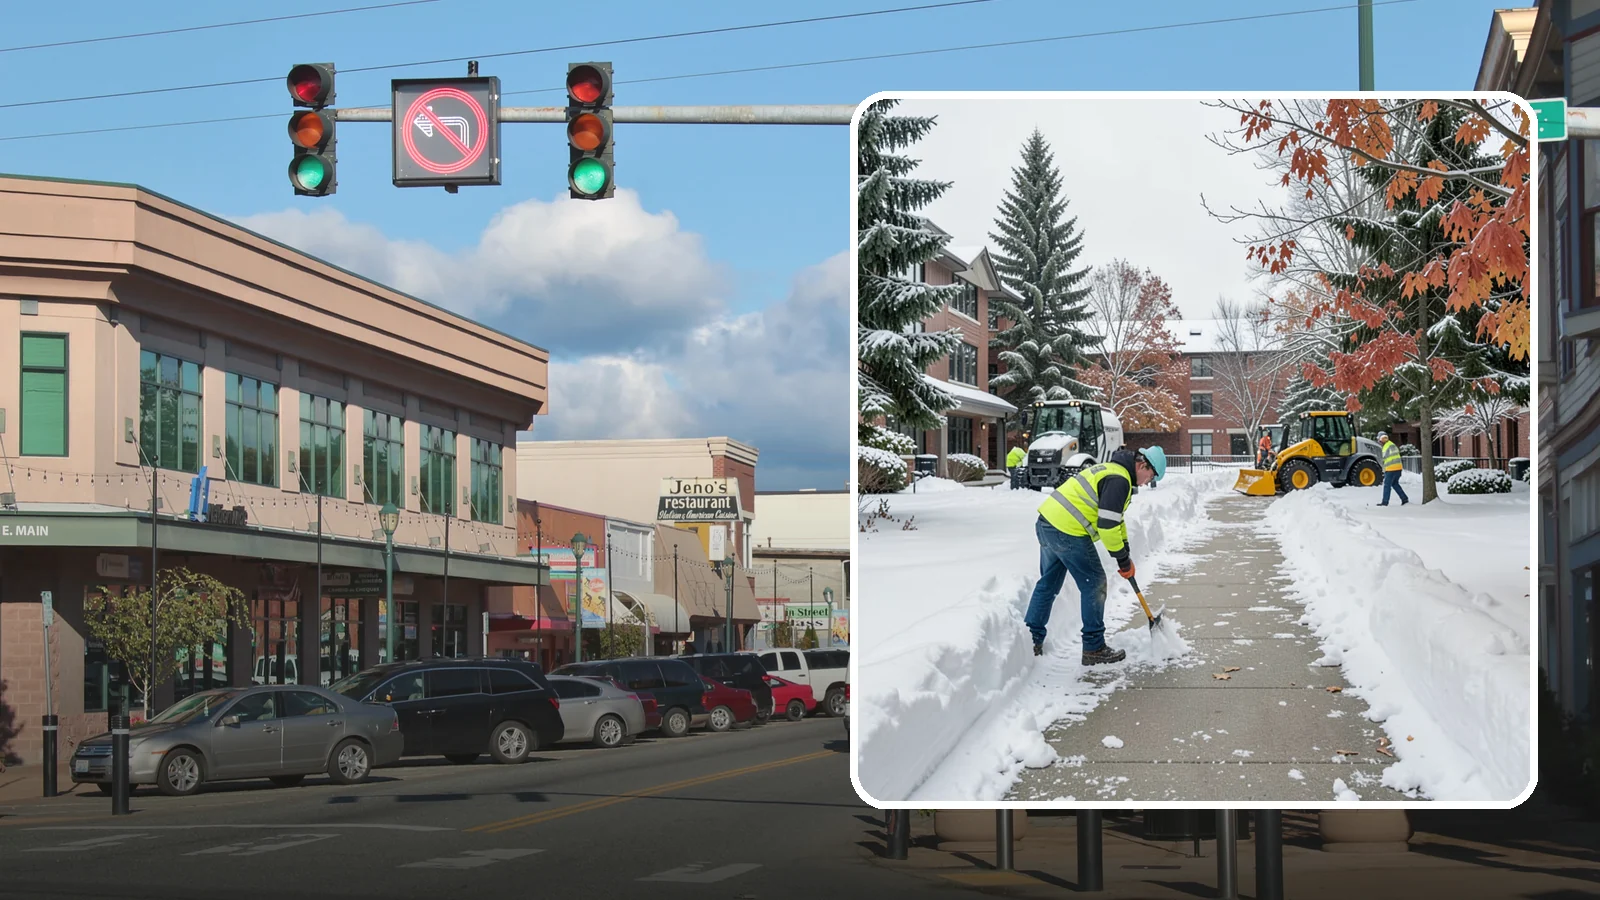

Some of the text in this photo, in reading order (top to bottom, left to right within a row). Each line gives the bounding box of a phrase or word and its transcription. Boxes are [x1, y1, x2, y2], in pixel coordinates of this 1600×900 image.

[669, 480, 728, 495] Jeno's
[664, 496, 731, 509] restaurant
[658, 510, 682, 520] Italian
[686, 510, 715, 520] American
[715, 509, 738, 520] Cuisine
[2, 525, 49, 536] E. MAIN
[797, 607, 829, 617] Street
